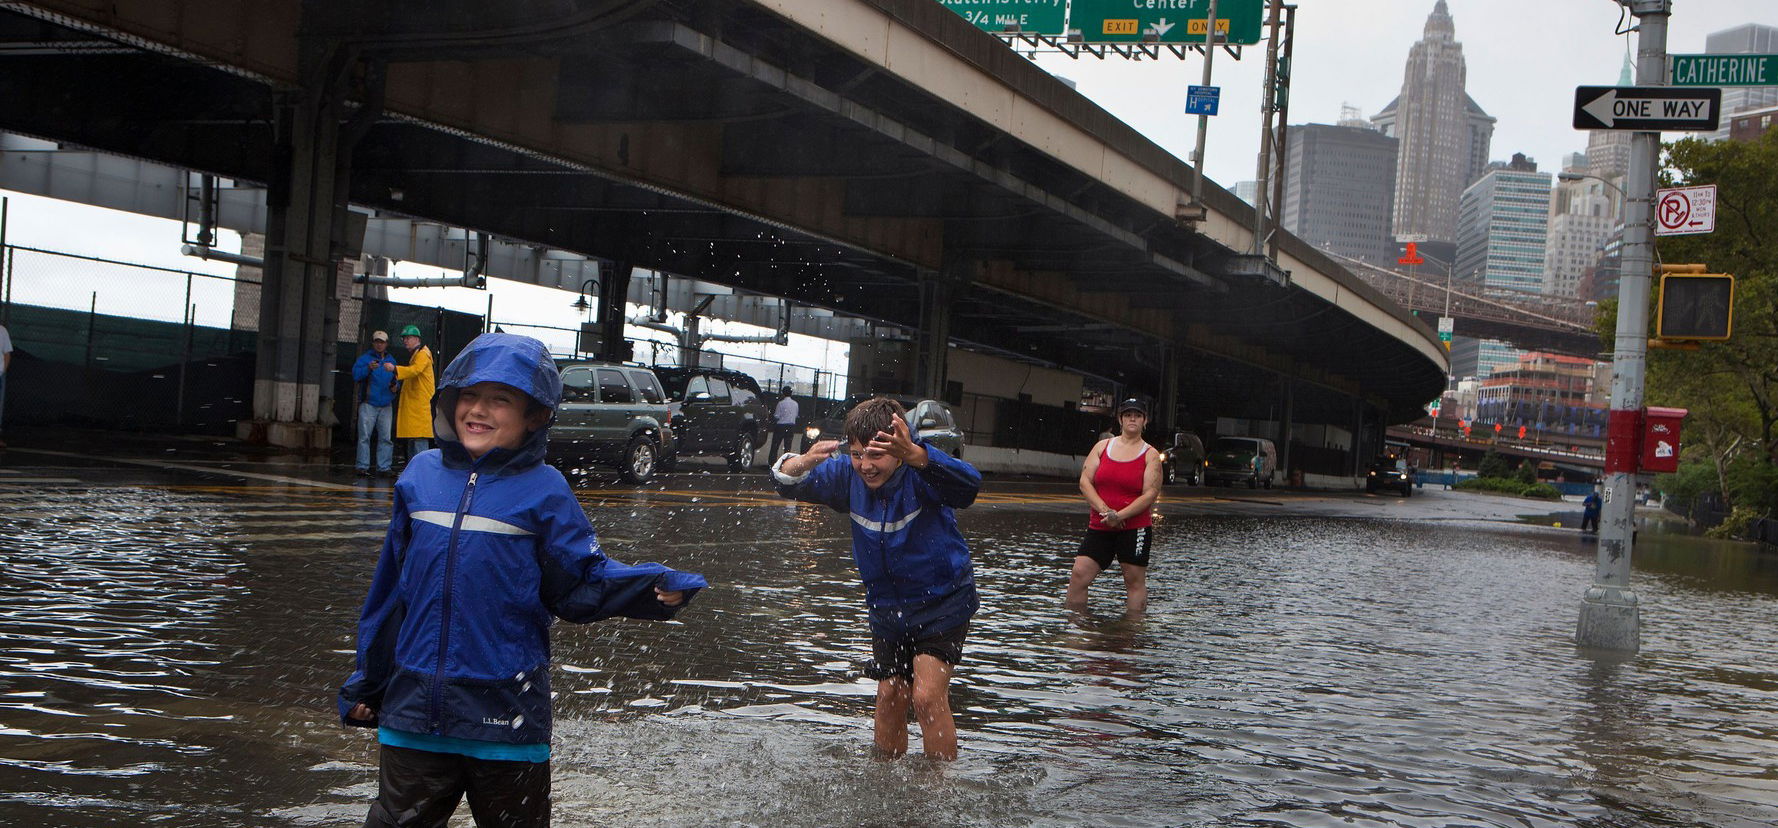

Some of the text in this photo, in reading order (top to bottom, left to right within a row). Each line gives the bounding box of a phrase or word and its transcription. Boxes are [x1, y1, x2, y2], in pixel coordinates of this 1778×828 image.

[1107, 22, 1134, 32] EXIT
[1192, 22, 1225, 32] ONY
[1677, 58, 1768, 83] CATHERINE
[1613, 100, 1705, 118] ONE WAY
